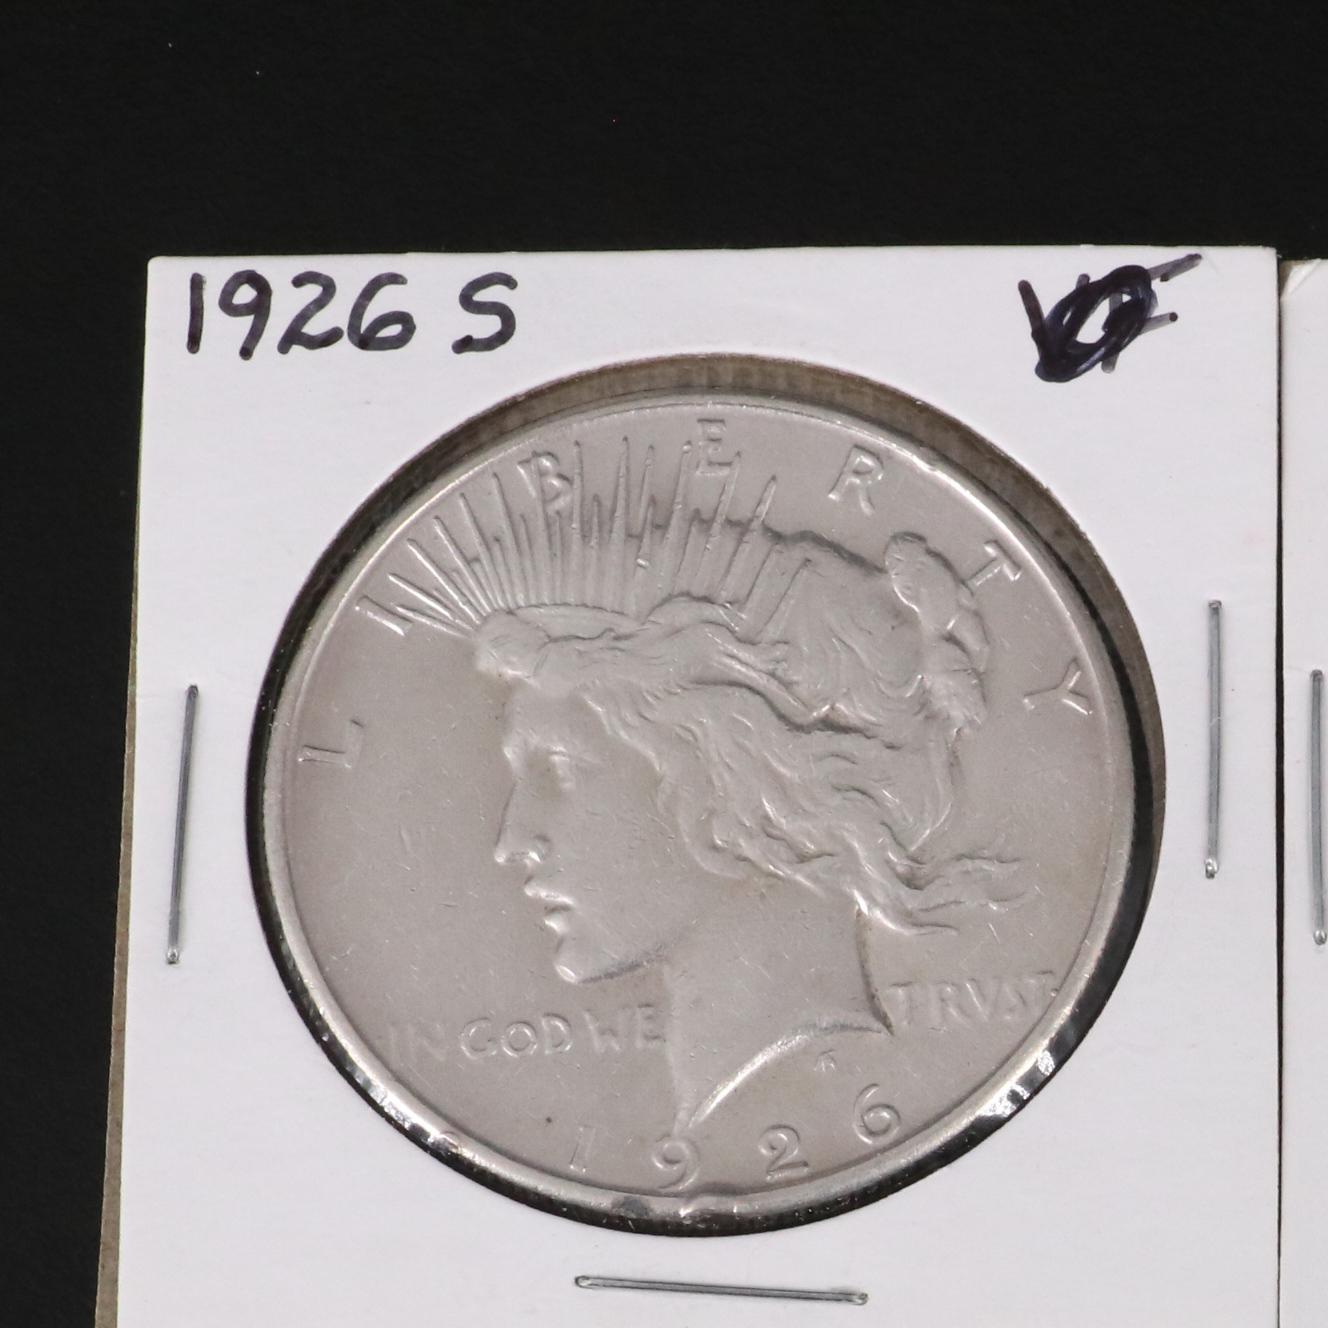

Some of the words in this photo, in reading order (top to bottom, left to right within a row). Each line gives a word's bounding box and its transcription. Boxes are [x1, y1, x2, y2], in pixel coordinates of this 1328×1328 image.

[187, 270, 416, 360] 1926
[451, 272, 518, 354] S
[459, 1011, 574, 1060] GOD
[584, 1003, 667, 1054] WE
[569, 1083, 901, 1190] 1926
